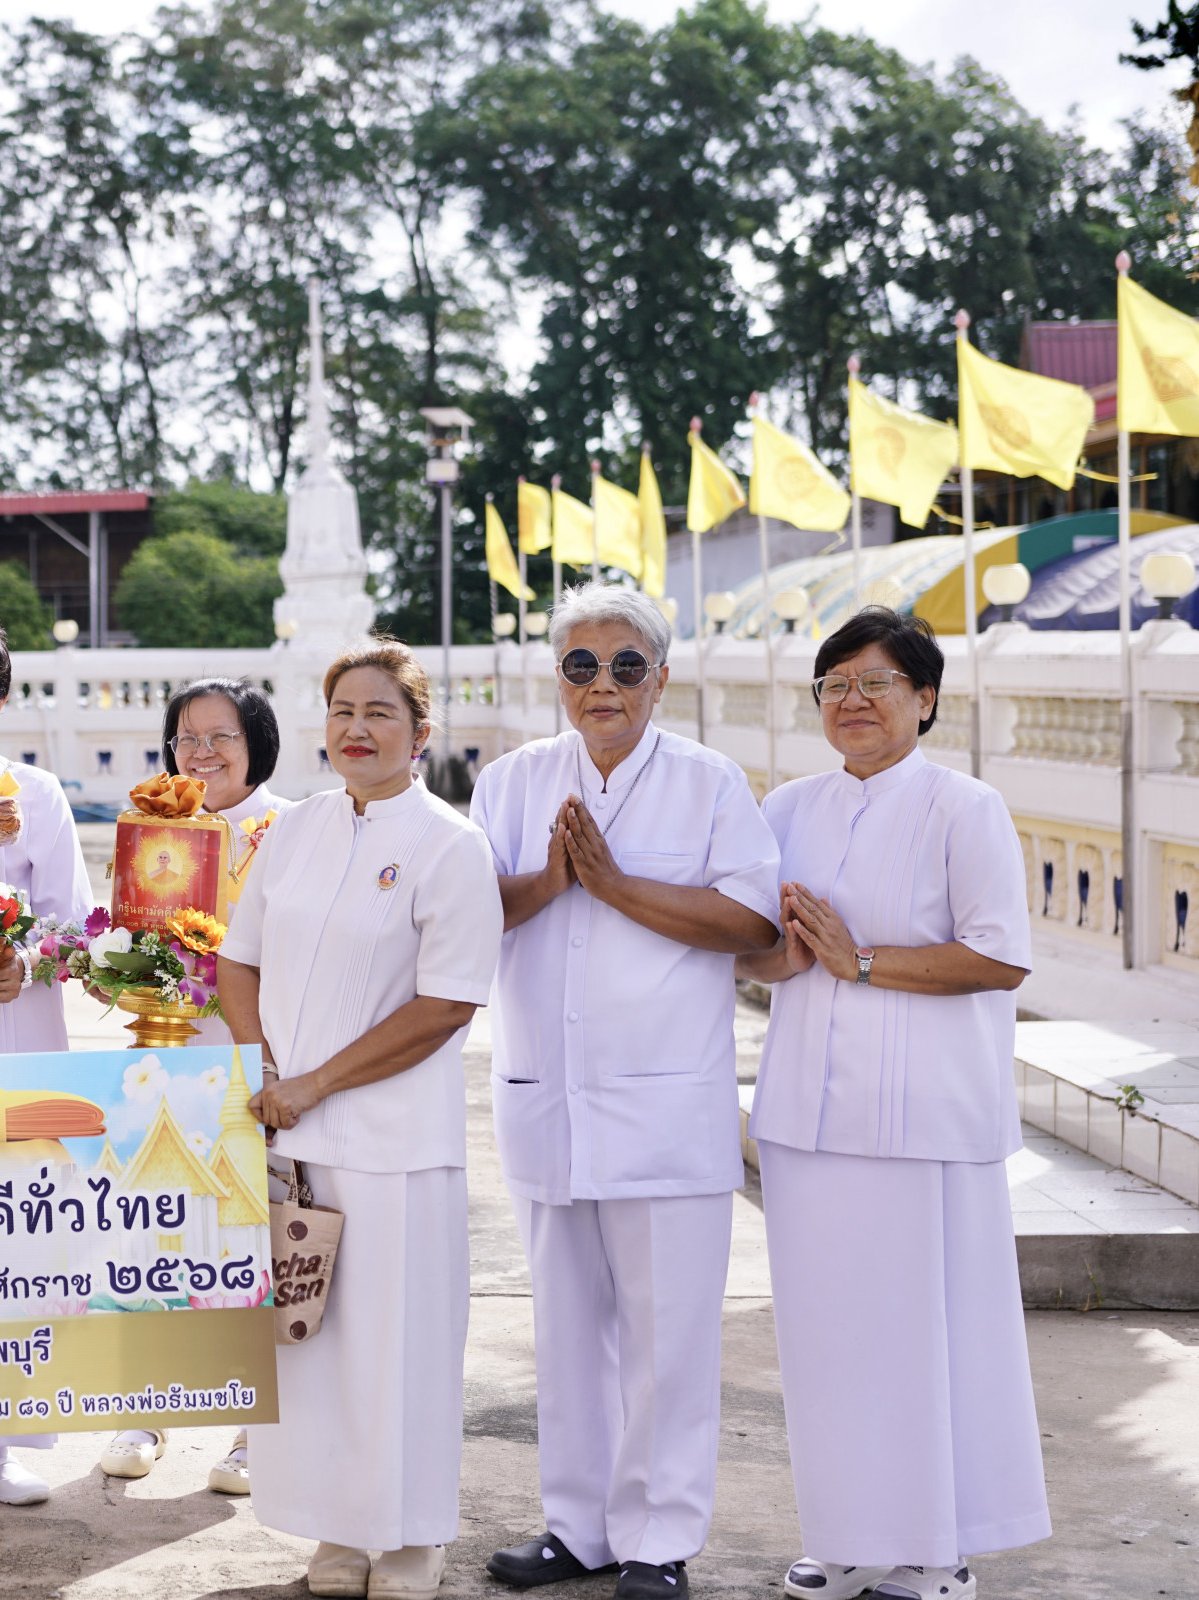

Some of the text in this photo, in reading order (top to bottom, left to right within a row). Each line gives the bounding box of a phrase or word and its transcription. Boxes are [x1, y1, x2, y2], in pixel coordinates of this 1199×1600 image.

[105, 1254, 255, 1296] ๒๕๖๘
[272, 1252, 322, 1281] cha
[274, 1278, 325, 1308] San
[19, 1400, 49, 1416] ๘๑
[57, 1390, 73, 1414] ปี
[82, 1382, 254, 1413] หลวงพ่อธัมมชโย
